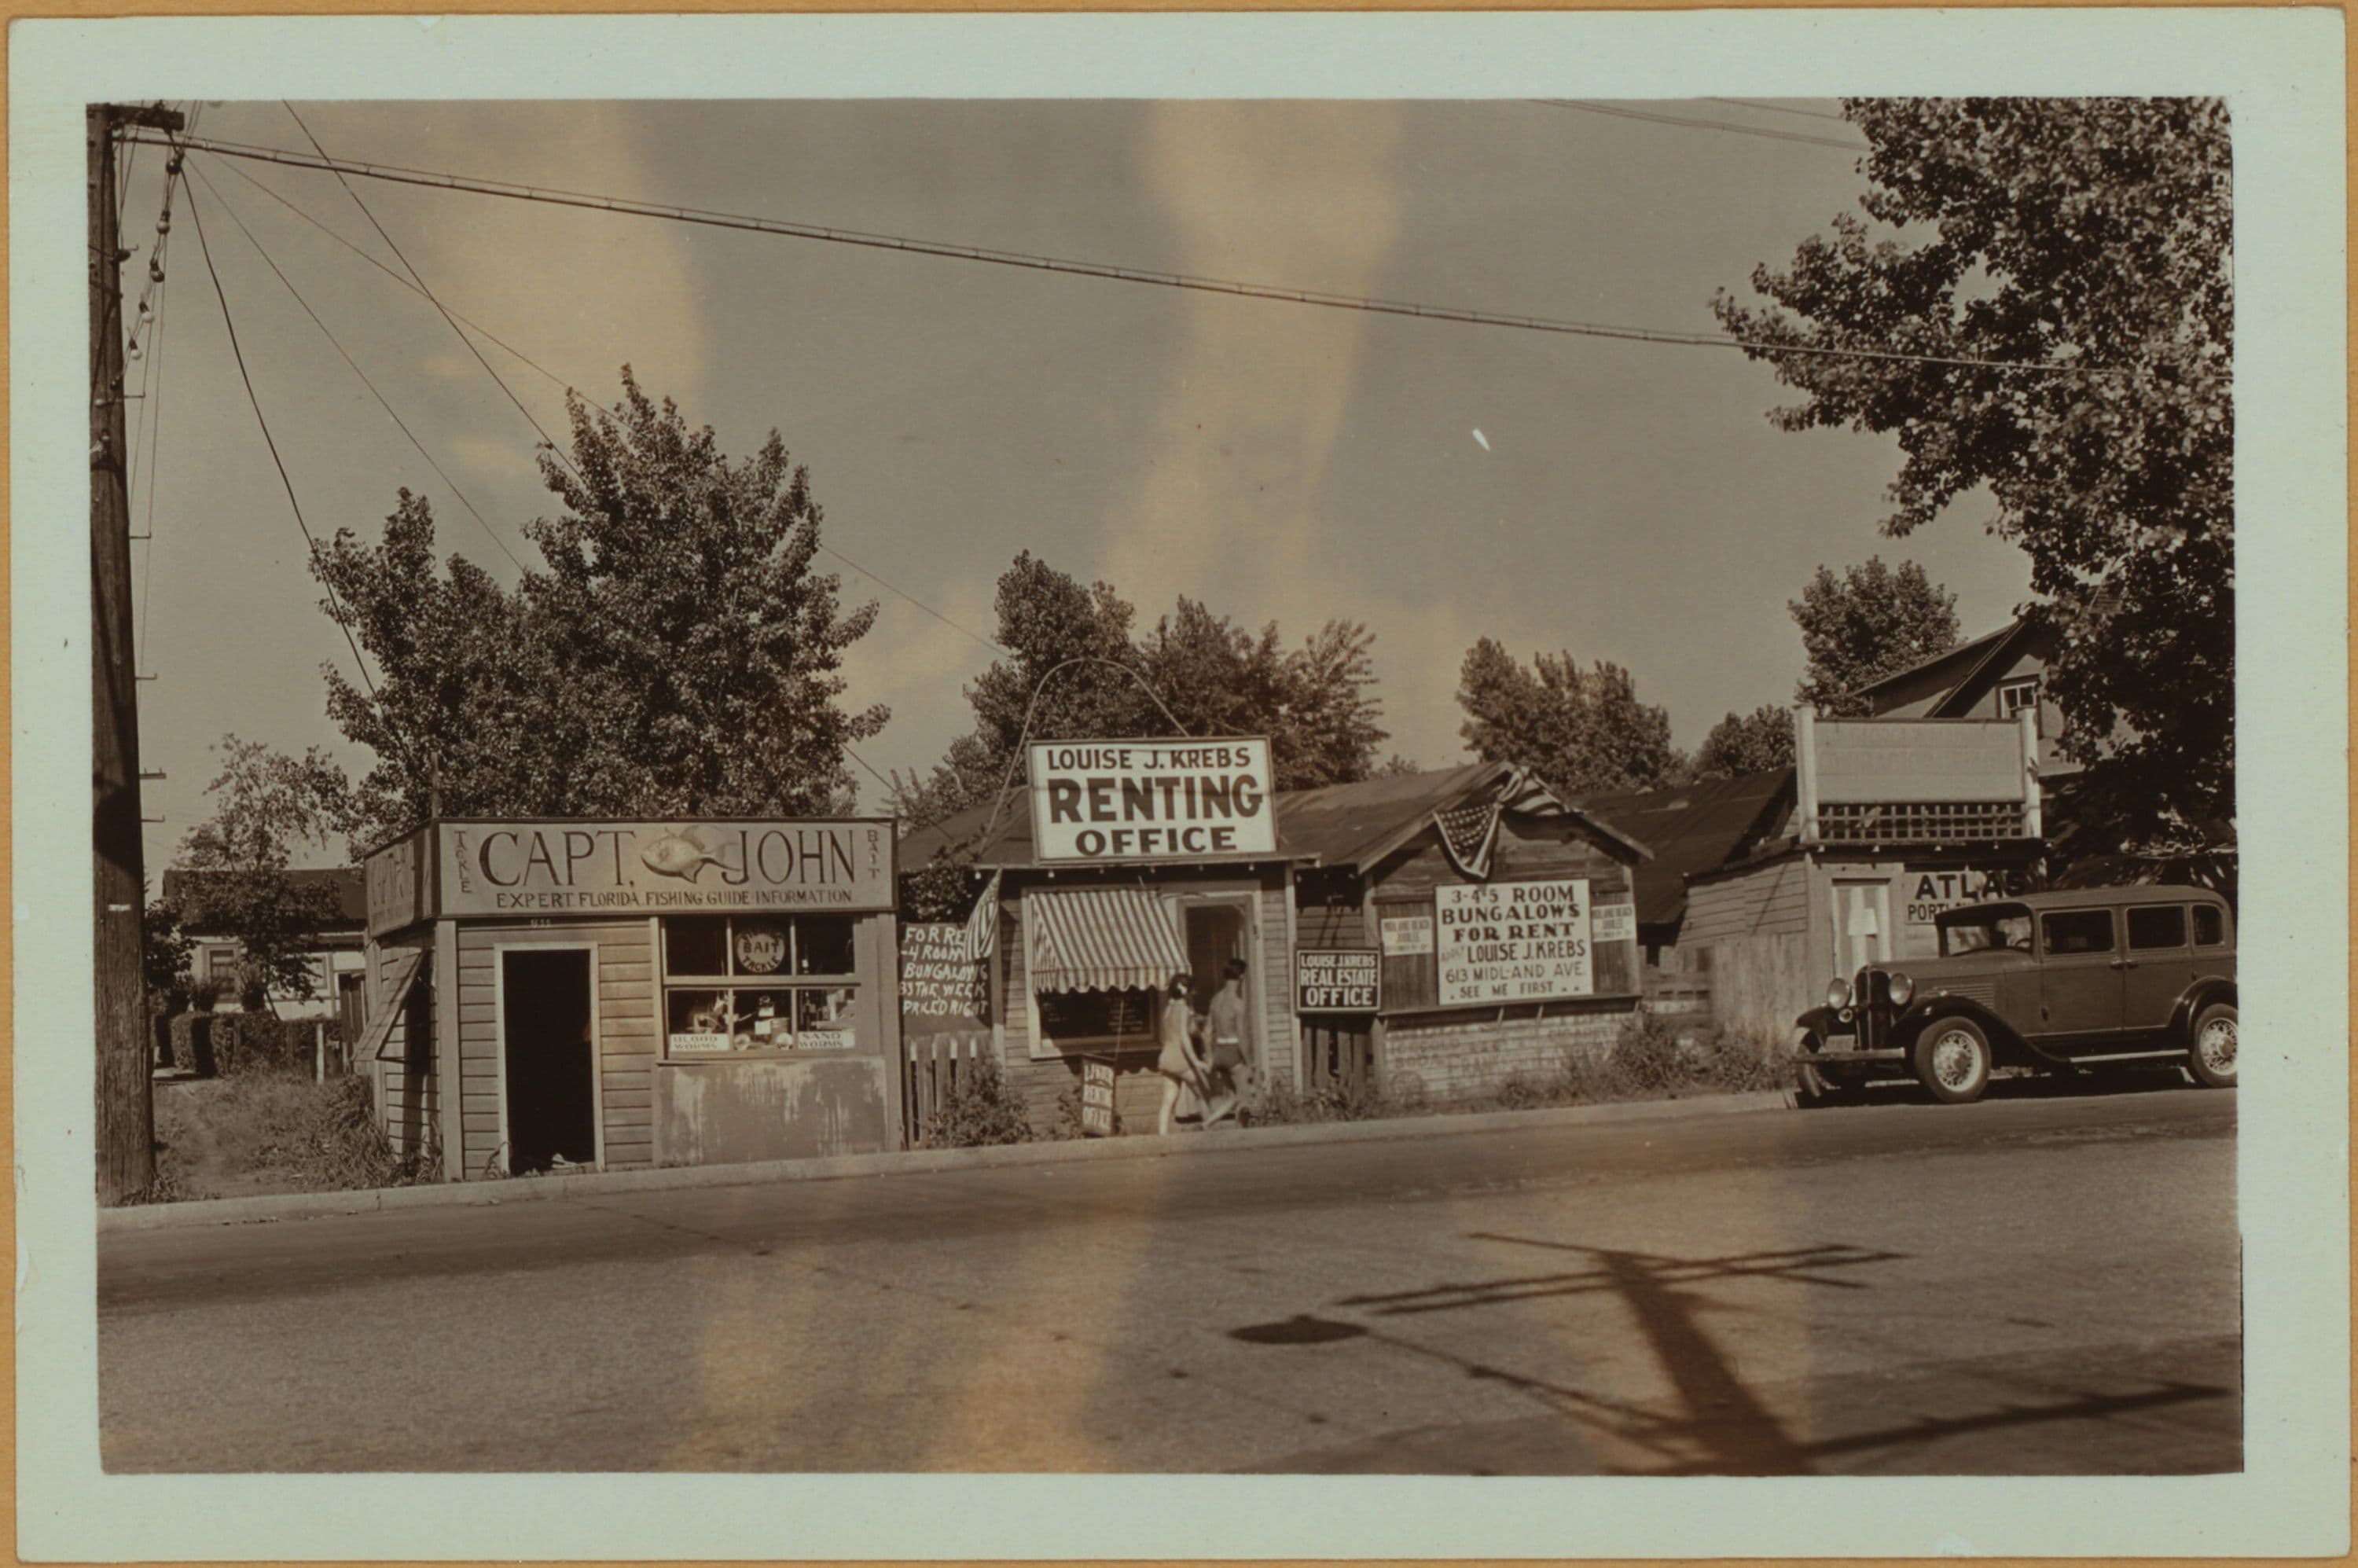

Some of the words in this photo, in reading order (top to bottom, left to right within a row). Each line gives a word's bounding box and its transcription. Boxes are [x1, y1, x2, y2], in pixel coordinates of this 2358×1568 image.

[1047, 749, 1133, 770] LOUISE
[1170, 747, 1251, 769] KREBS
[1048, 773, 1263, 823] RENTING
[1076, 827, 1236, 856] OFFICE
[454, 830, 472, 894] TACKLE
[478, 831, 636, 887] CAPT.
[721, 829, 855, 886] JOHN
[866, 829, 880, 880] BAIT
[497, 892, 574, 909] EXPERT
[579, 891, 639, 907] FLORIDA
[645, 890, 703, 906] FISHING
[707, 890, 750, 905] GUIDE
[755, 889, 854, 905] INFORMATION
[1511, 884, 1574, 904] ROOM
[1442, 903, 1581, 925] BUNGALOWS
[904, 927, 941, 944] FOR
[942, 927, 968, 946] RE
[1453, 927, 1500, 943] FOR
[1508, 922, 1575, 940] RENT
[743, 942, 779, 953] BAIT
[1467, 943, 1519, 964] LOUISE
[1301, 955, 1336, 967] LOUISE
[1301, 968, 1335, 986] REAL
[1336, 968, 1377, 986] ESTATE
[1445, 968, 1469, 985] 613
[914, 980, 940, 998] THE
[942, 982, 986, 1000] WEEK
[1306, 987, 1373, 1006] OFFICE
[1460, 985, 1481, 1000] SEE
[1491, 982, 1508, 997] ME
[1519, 980, 1554, 994] FIRST
